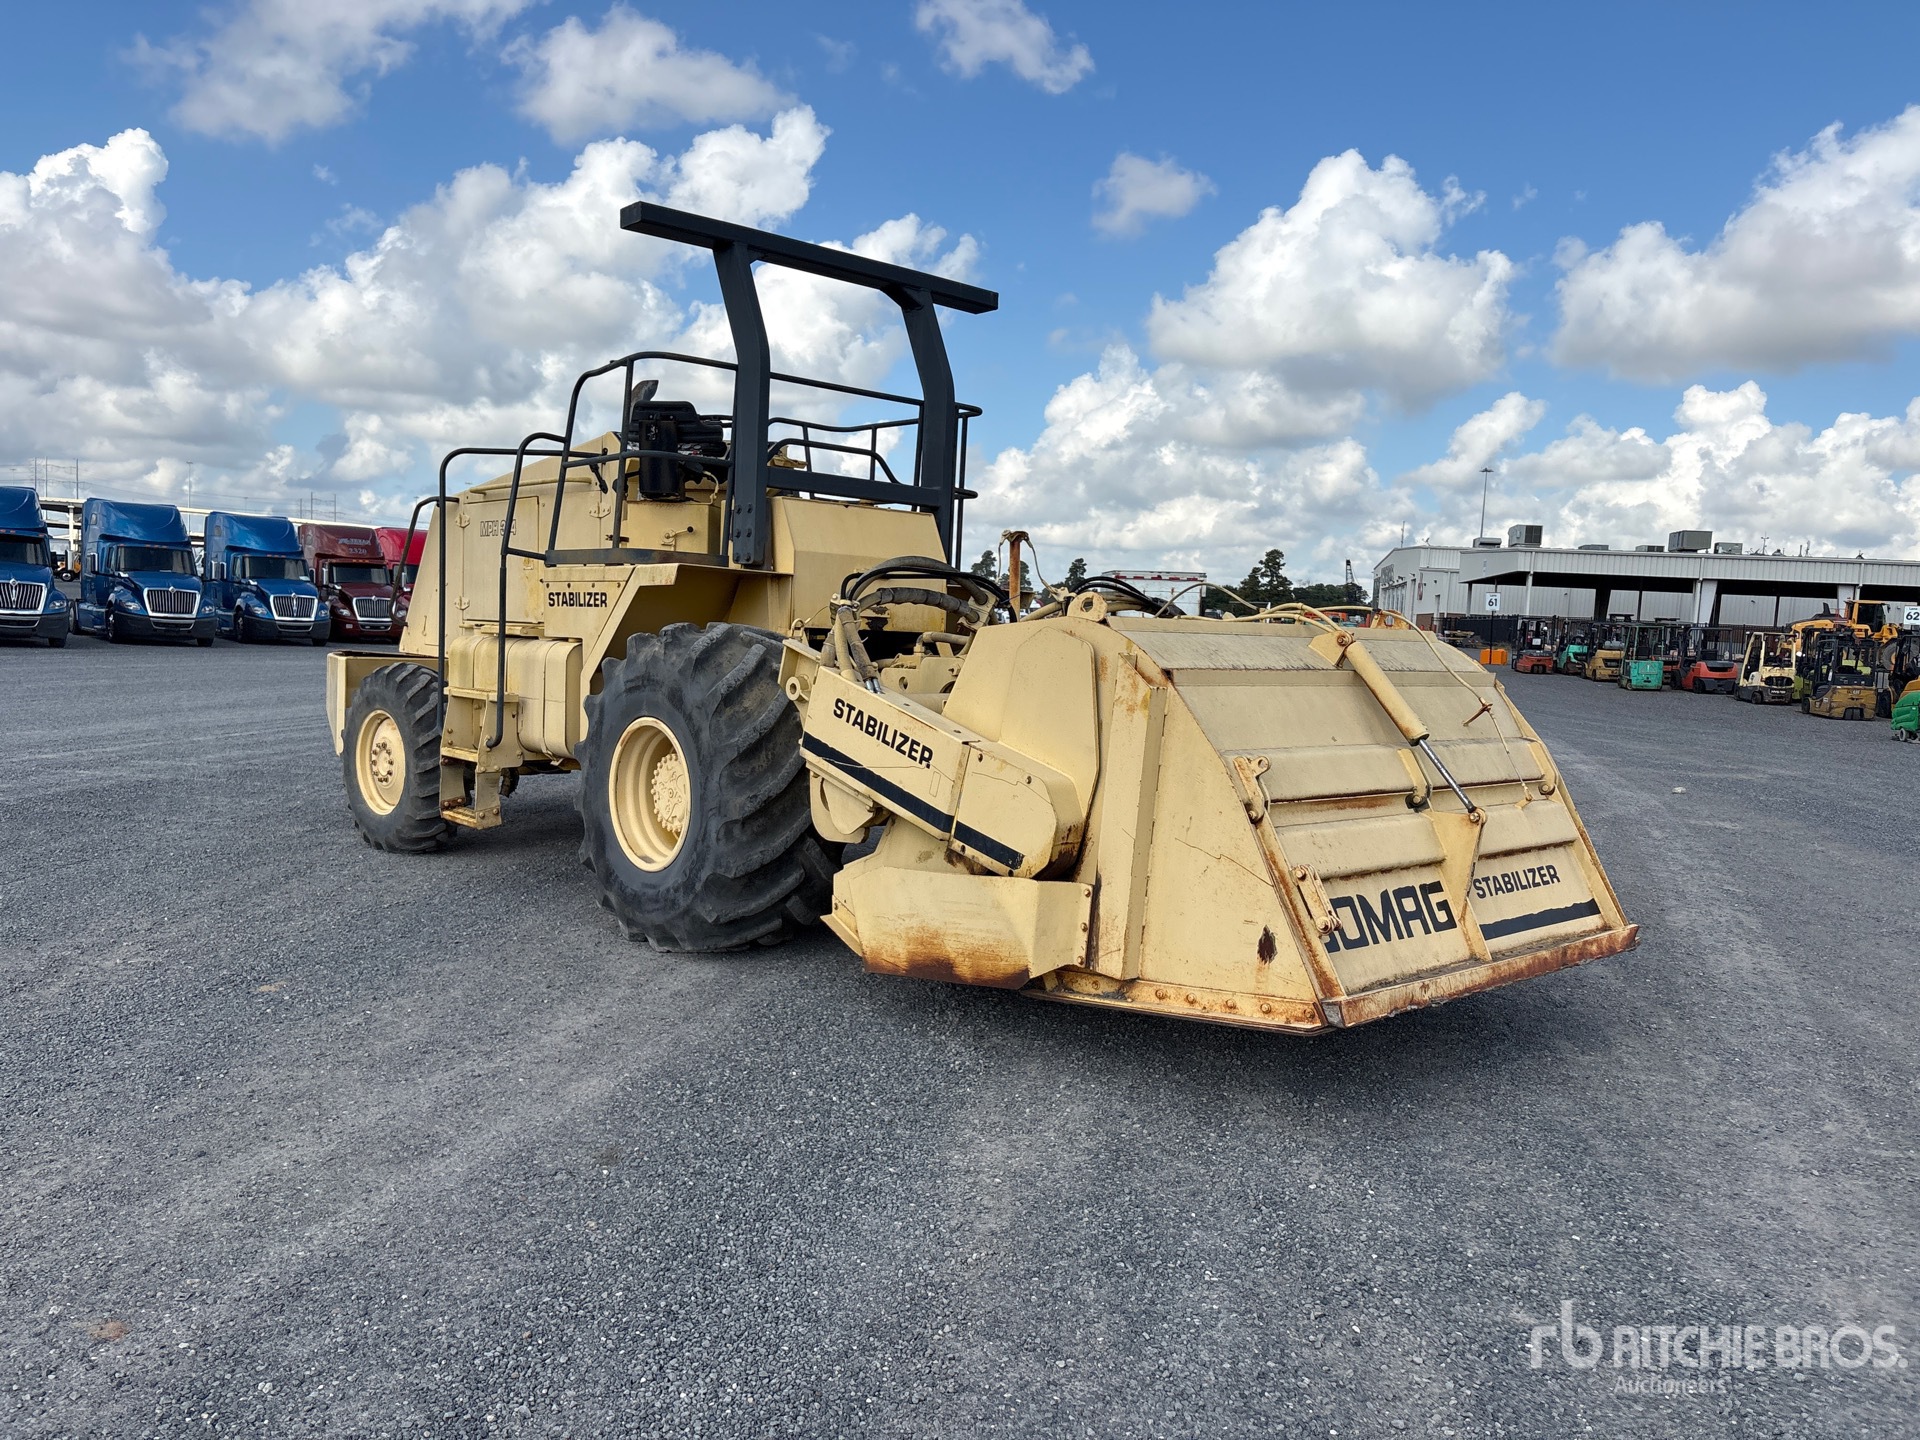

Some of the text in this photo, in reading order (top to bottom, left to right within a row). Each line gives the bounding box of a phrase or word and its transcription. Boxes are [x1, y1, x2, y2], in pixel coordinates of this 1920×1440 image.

[480, 519, 517, 537] MPH 34
[548, 592, 608, 608] STABILIZER
[1488, 598, 1498, 607] 61
[1906, 611, 1920, 621] 62
[833, 698, 934, 769] STABILIZER
[1472, 864, 1561, 899] STABILIZER
[1324, 880, 1457, 954] OMAG
